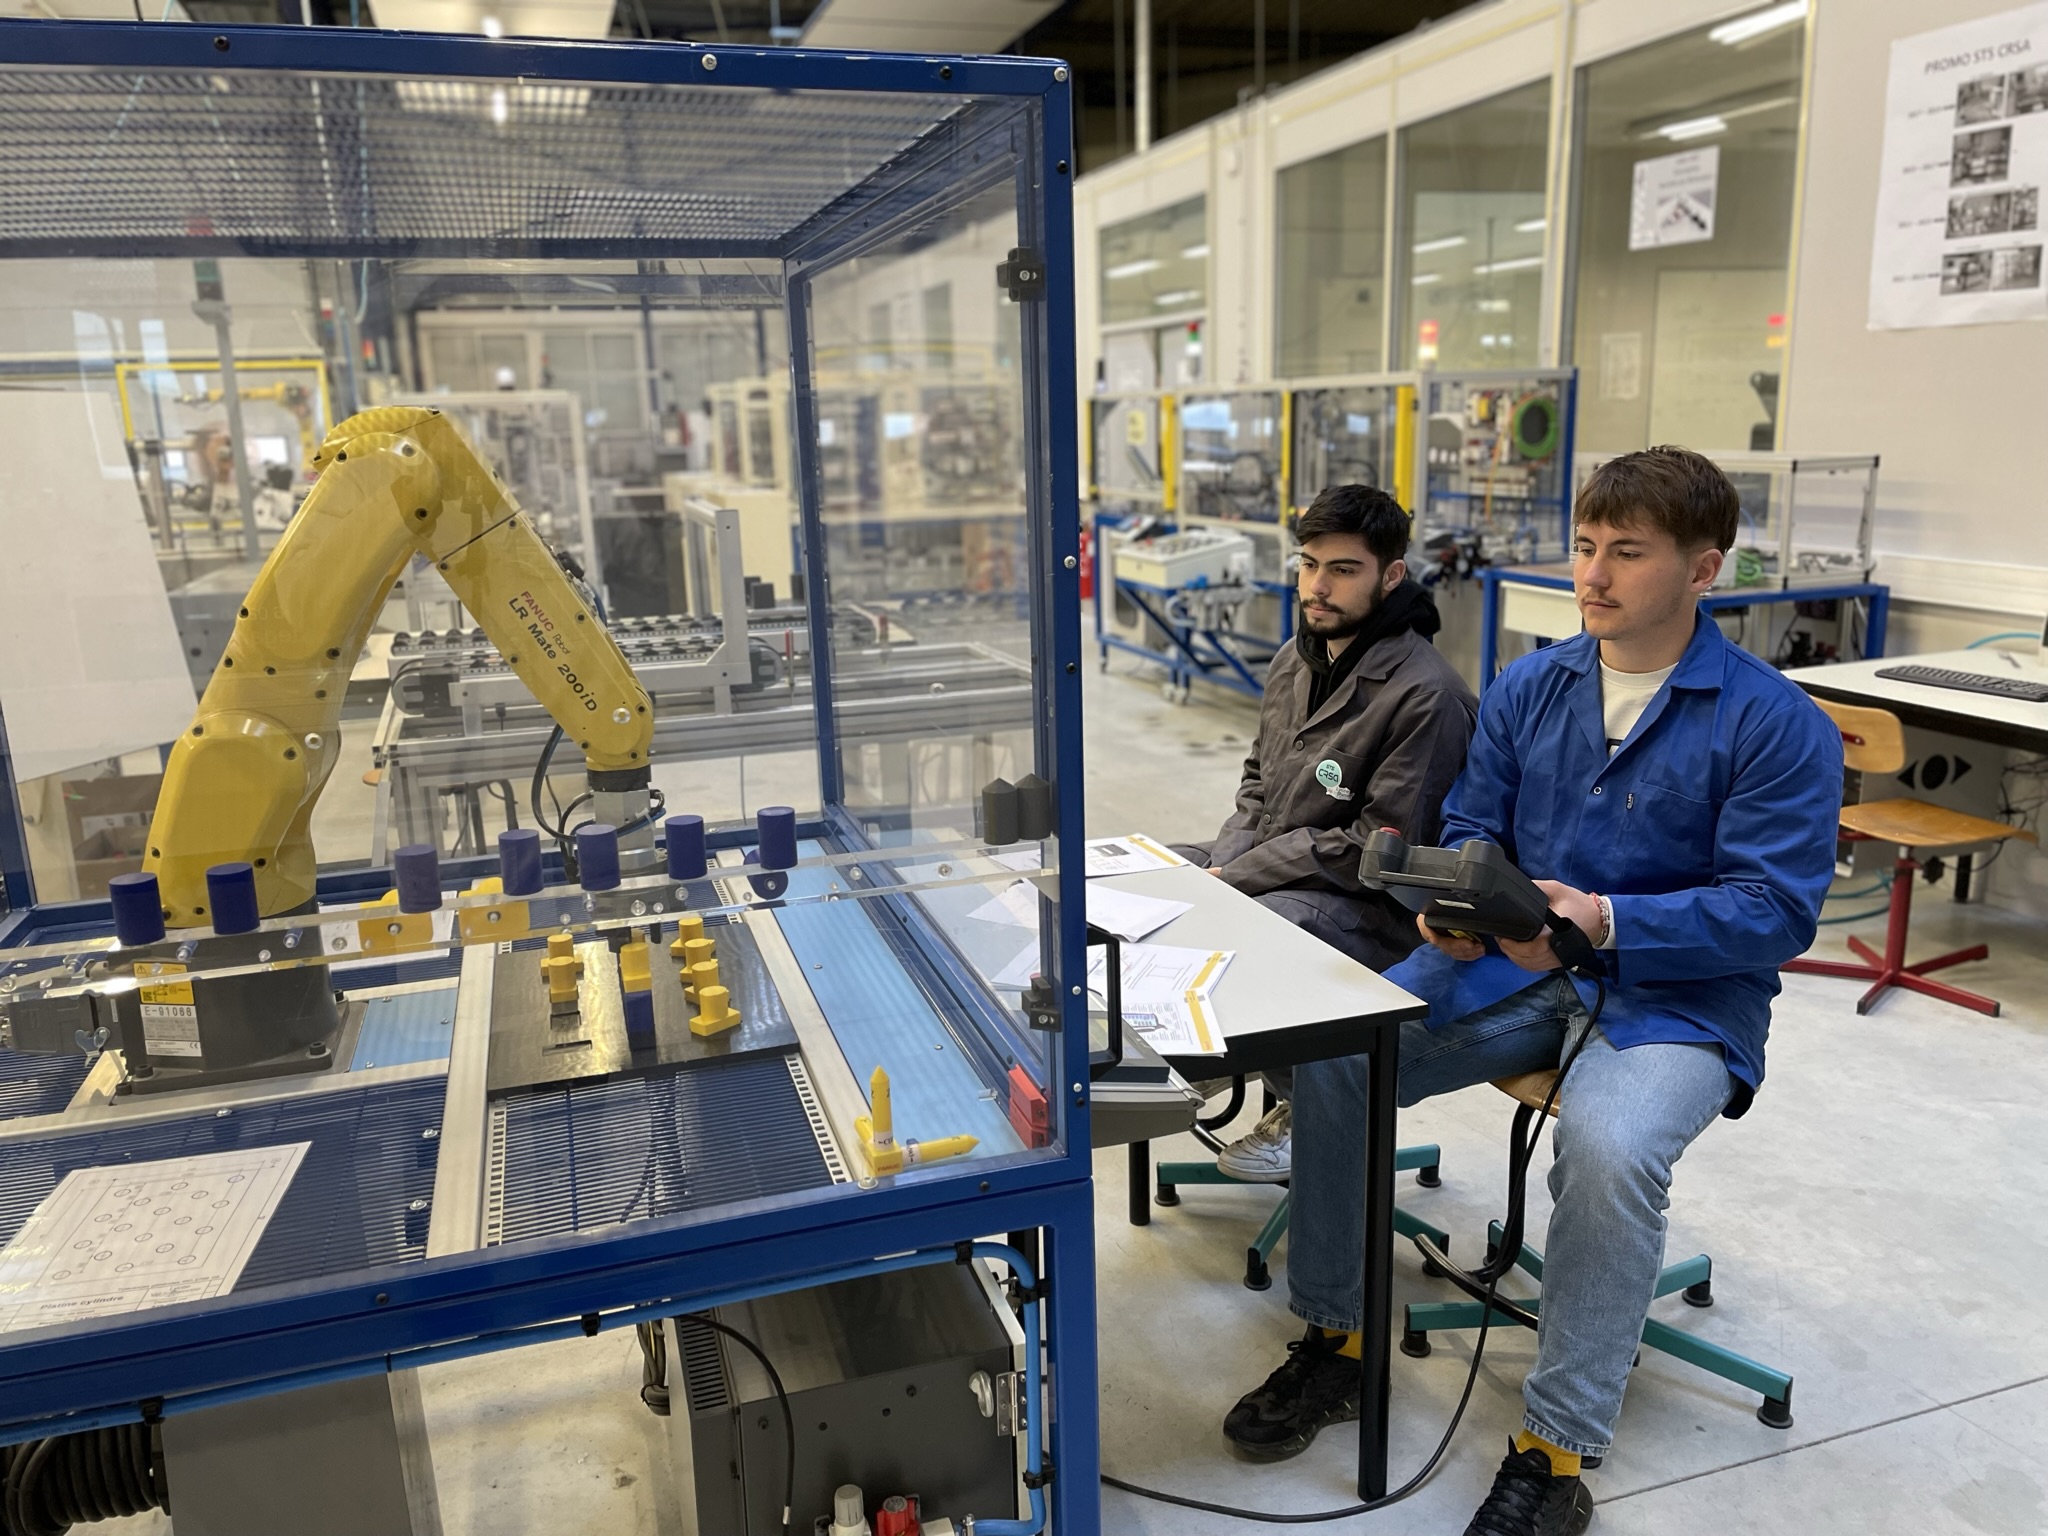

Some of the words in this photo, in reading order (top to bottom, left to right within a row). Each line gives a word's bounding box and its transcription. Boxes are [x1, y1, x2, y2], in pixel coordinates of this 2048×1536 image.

[1924, 52, 1971, 75] PROMO
[1973, 46, 1995, 64] STS
[520, 591, 554, 632] FANUC
[552, 633, 571, 656] Robot
[508, 597, 529, 620] LR
[527, 623, 557, 659] Mate
[557, 663, 597, 712] 200iD
[877, 1163, 900, 1173] FANUC
[39, 1301, 78, 1310] Platine
[80, 1296, 124, 1306] cylindre
